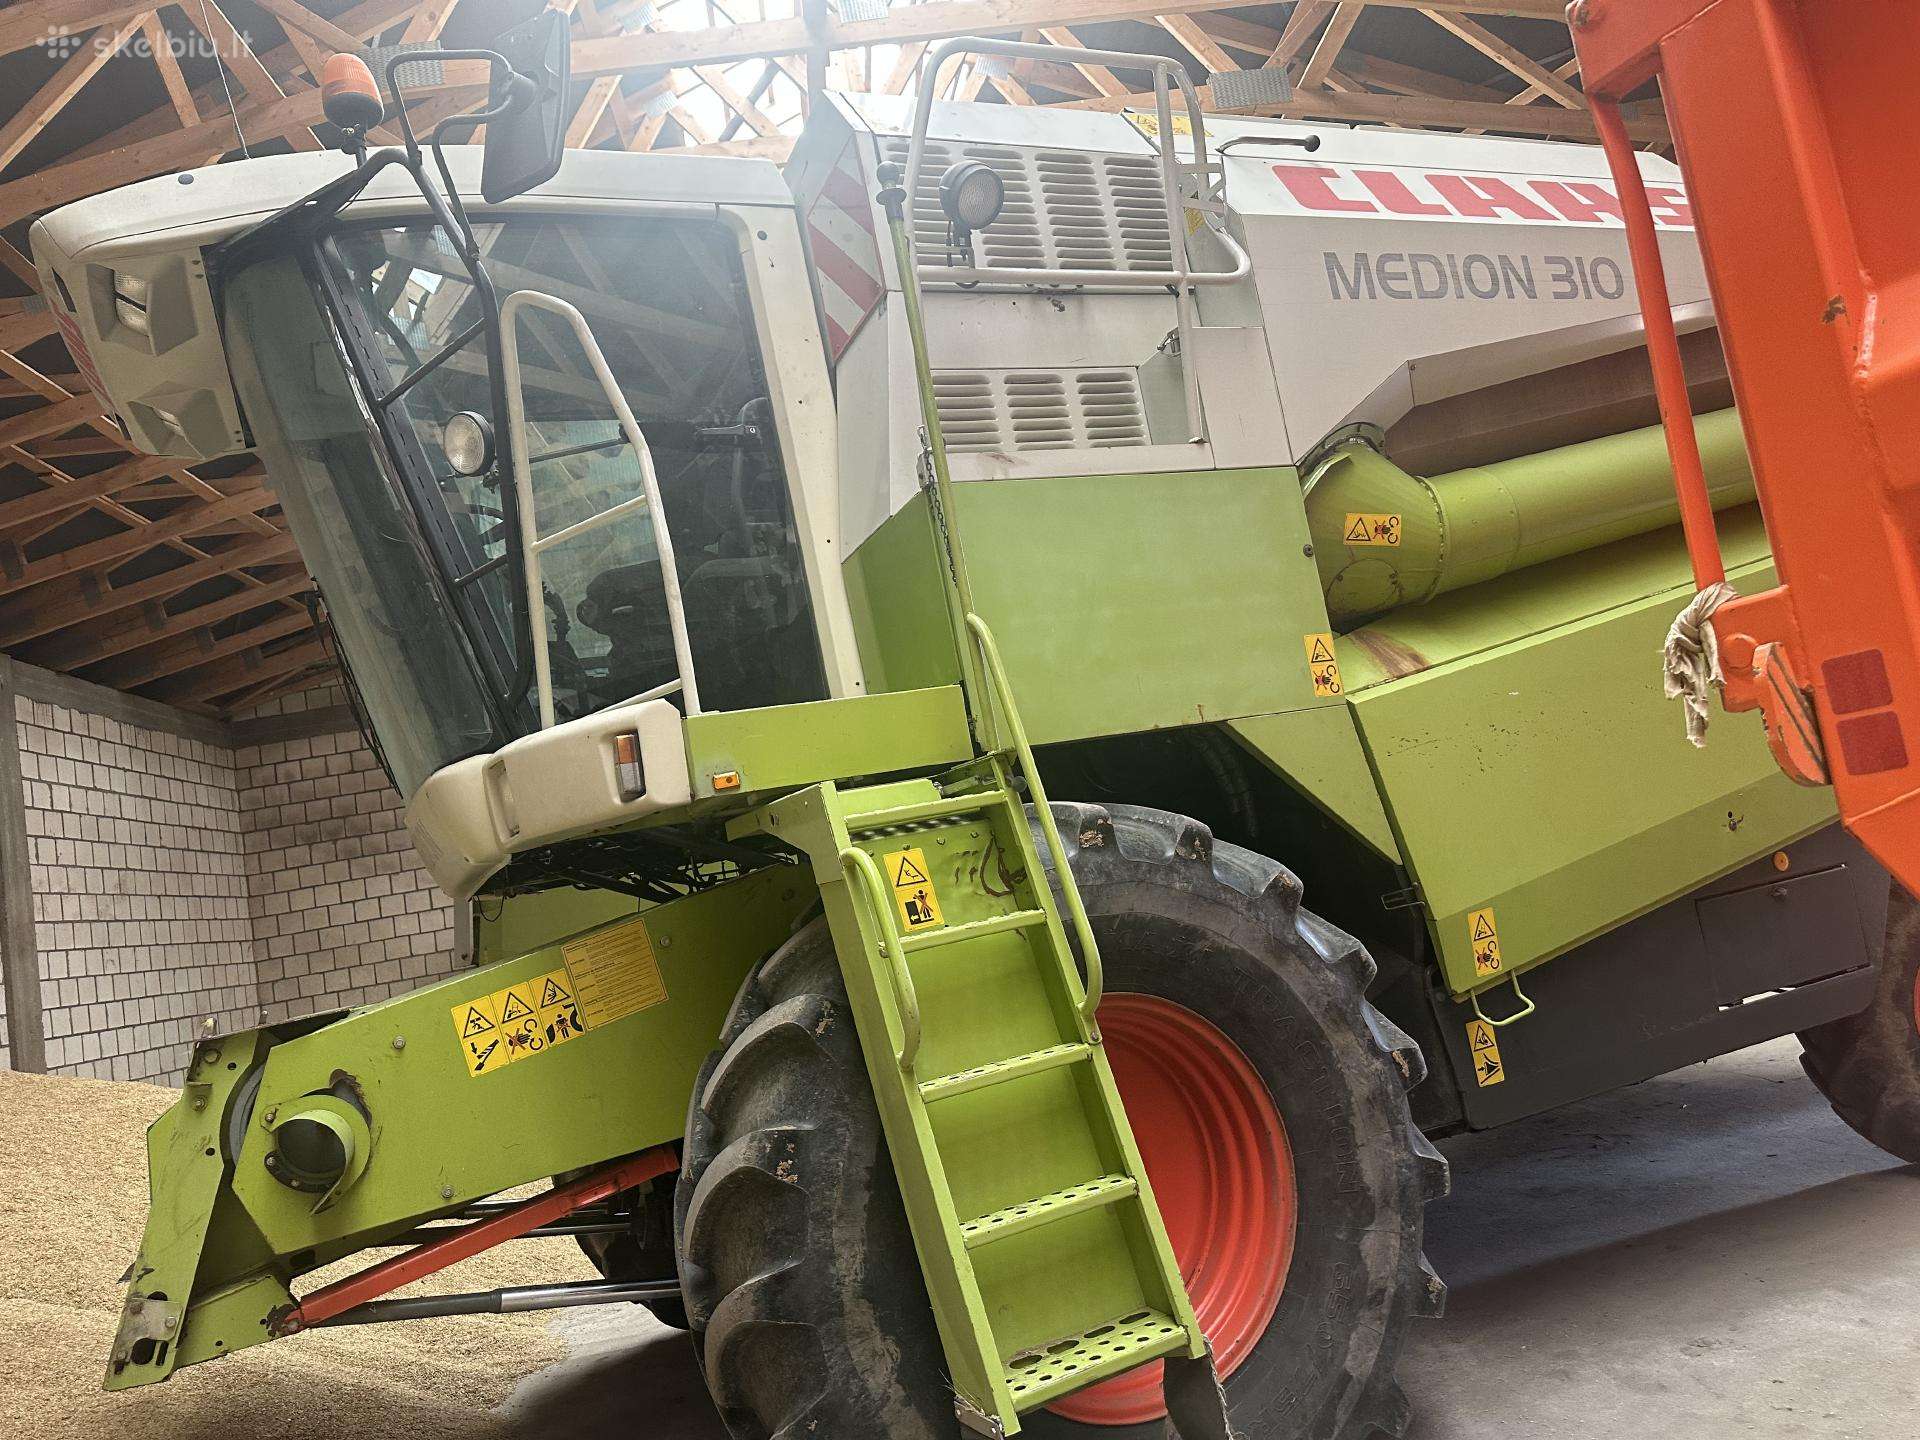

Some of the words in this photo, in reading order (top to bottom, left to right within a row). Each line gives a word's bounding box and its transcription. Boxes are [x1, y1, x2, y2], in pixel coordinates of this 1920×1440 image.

[1272, 165, 1695, 226] CLAAS
[1323, 251, 1538, 300] MEDION
[1544, 256, 1625, 300] 310
